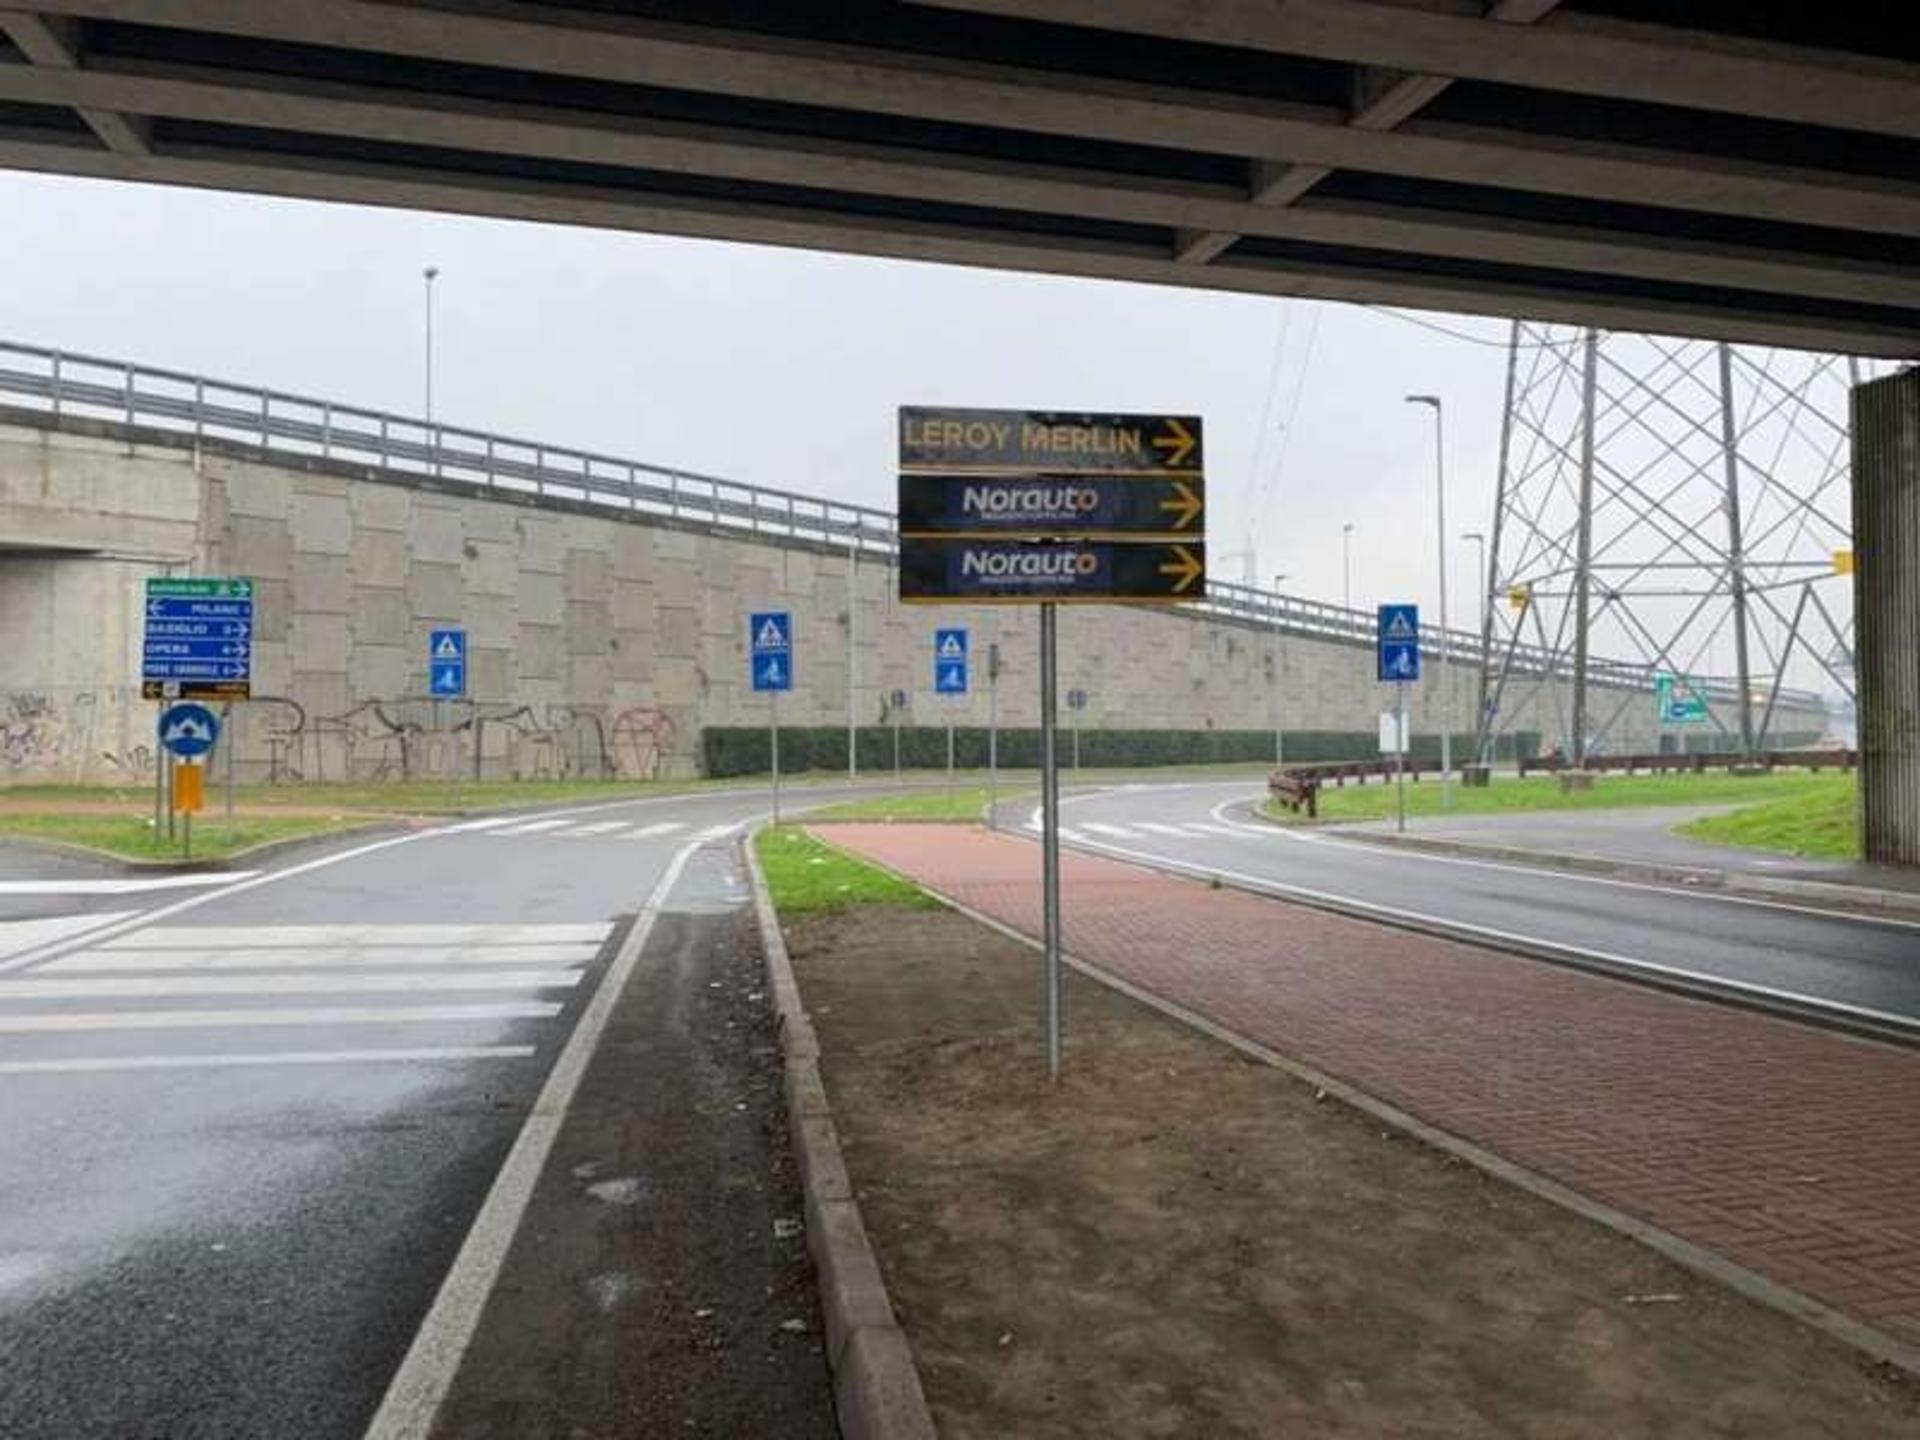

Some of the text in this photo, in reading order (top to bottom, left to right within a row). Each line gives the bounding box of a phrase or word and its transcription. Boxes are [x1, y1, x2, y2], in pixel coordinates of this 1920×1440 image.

[905, 420, 1141, 453] LEROY MERLIN
[963, 486, 1098, 512] Norauto
[962, 549, 1097, 576] Norauto
